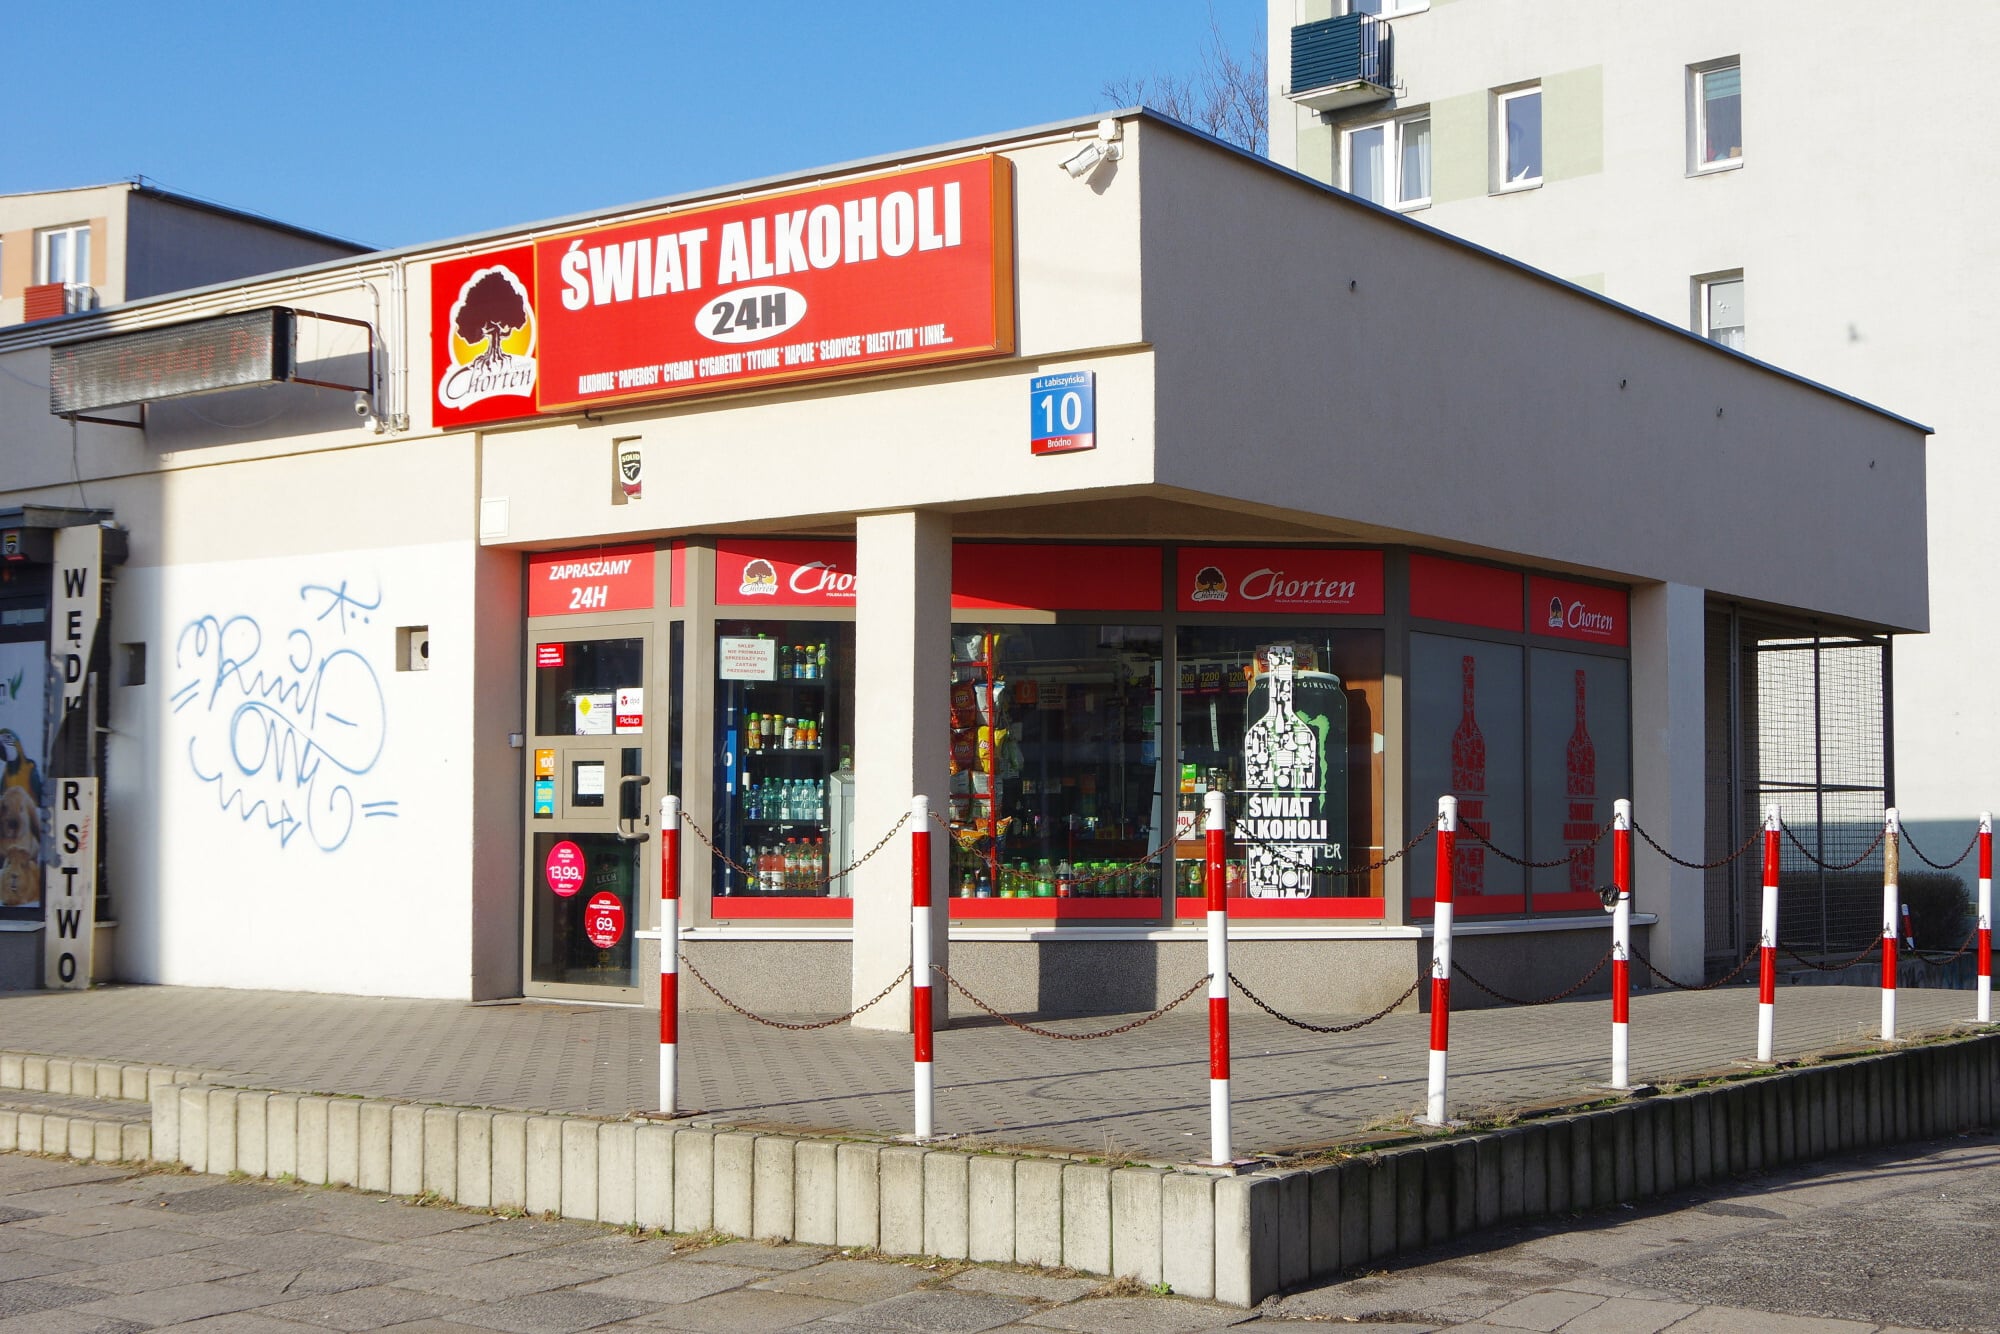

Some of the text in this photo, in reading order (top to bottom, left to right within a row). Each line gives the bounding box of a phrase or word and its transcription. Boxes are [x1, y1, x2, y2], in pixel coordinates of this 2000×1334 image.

[560, 181, 961, 312] ŚWIAT ALKOHOLI
[711, 291, 787, 336] 24H
[578, 371, 615, 395] ALKOHOLE
[618, 364, 659, 389] PAPIEROSY
[663, 359, 695, 382] CYGARA
[699, 352, 742, 377] CYGARETKI
[746, 347, 780, 371] TYTONIE
[784, 342, 815, 366] NAPOJE
[820, 335, 861, 361] SŁODYCZE
[866, 330, 896, 355] BILETY
[895, 328, 914, 350] ZTM
[446, 365, 531, 400] Chorten
[1045, 374, 1085, 387] Łabiszyńska
[1041, 391, 1082, 433] 10
[1047, 437, 1072, 448] Bródno
[621, 453, 640, 463] SOLID
[549, 559, 632, 581] ZAPRASZAMY
[1239, 568, 1356, 601] Chorten
[569, 585, 608, 609] 24H
[1567, 600, 1613, 631] Chorten
[1201, 671, 1220, 683] 1200
[620, 715, 640, 726] Pickup
[1249, 793, 1313, 818] ŚWIAT
[1234, 819, 1327, 840] ALKOHOLI
